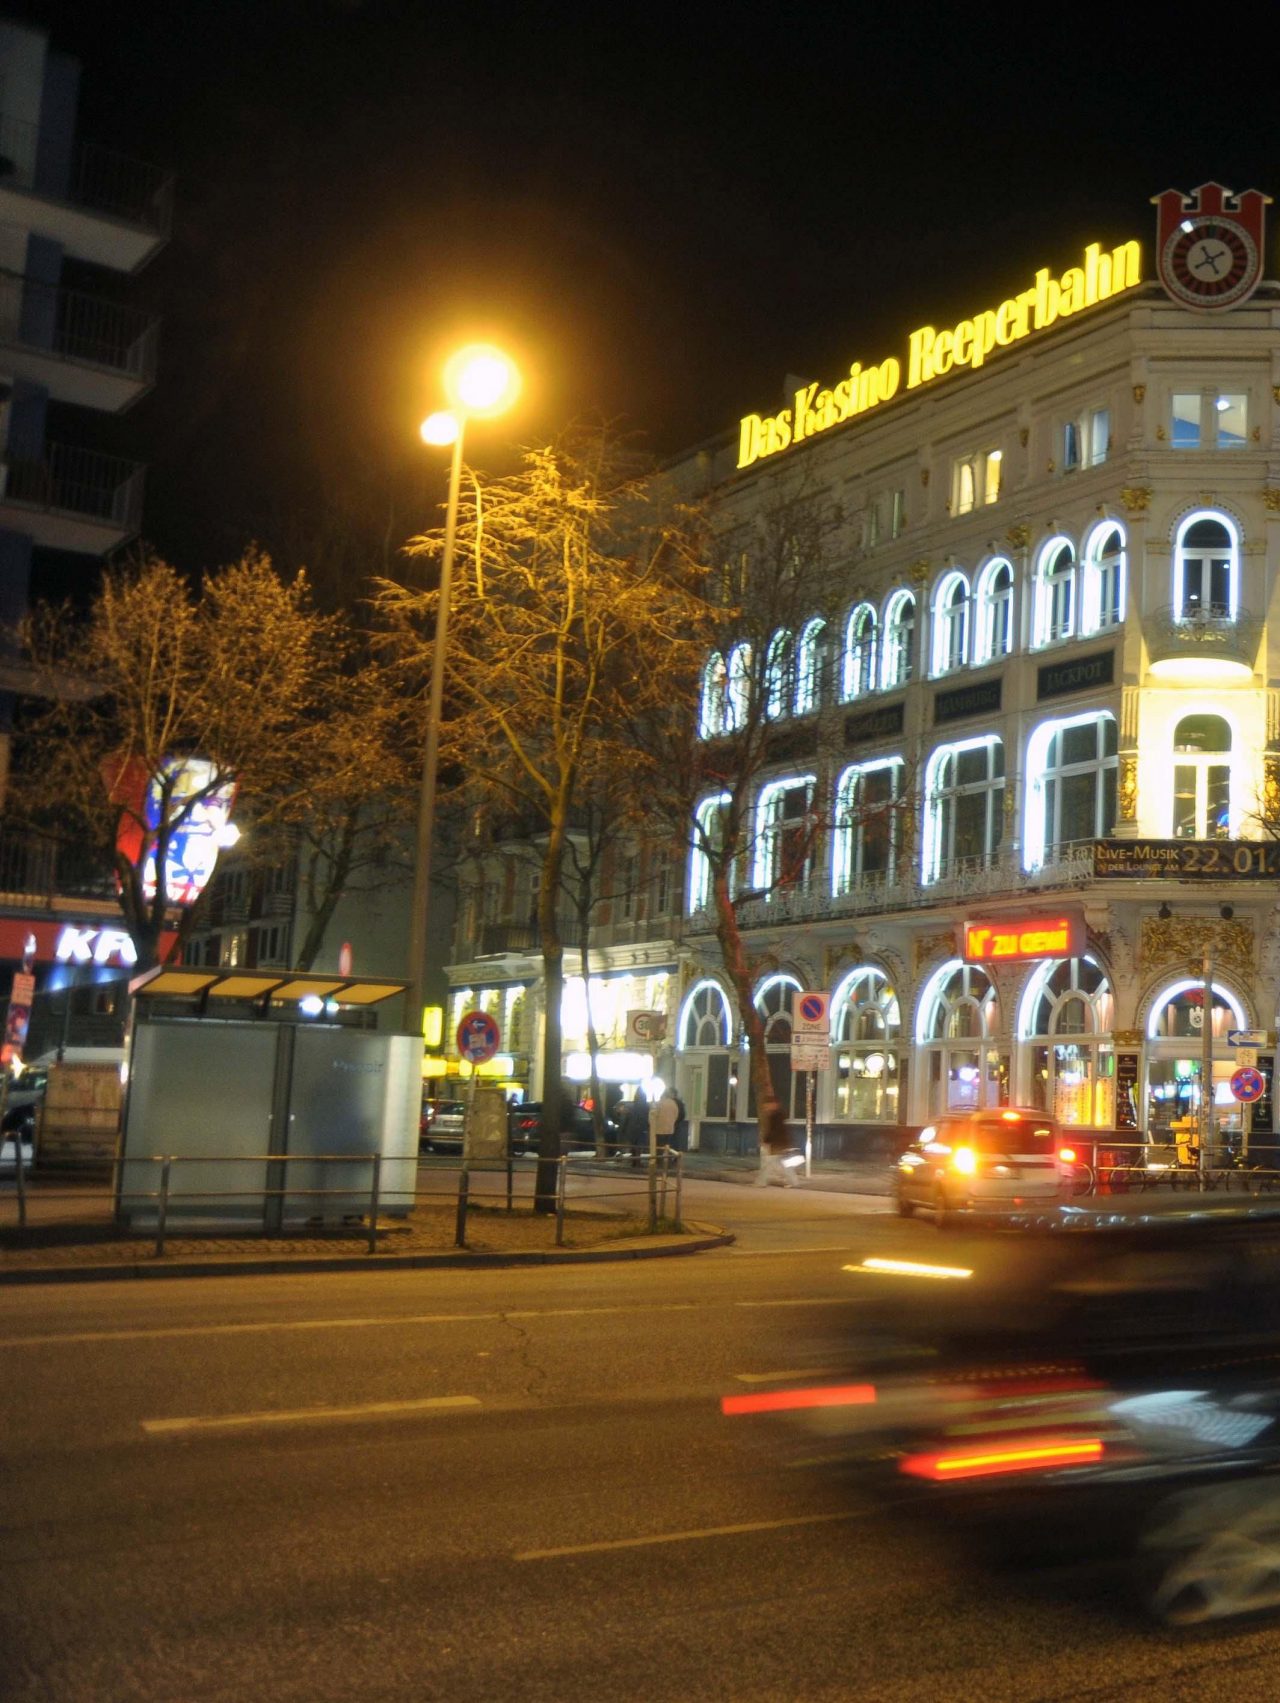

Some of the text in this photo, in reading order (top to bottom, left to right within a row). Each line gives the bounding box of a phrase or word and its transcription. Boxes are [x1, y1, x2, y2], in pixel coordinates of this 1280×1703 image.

[736, 240, 1141, 470] Das Kasino Reeperbahn
